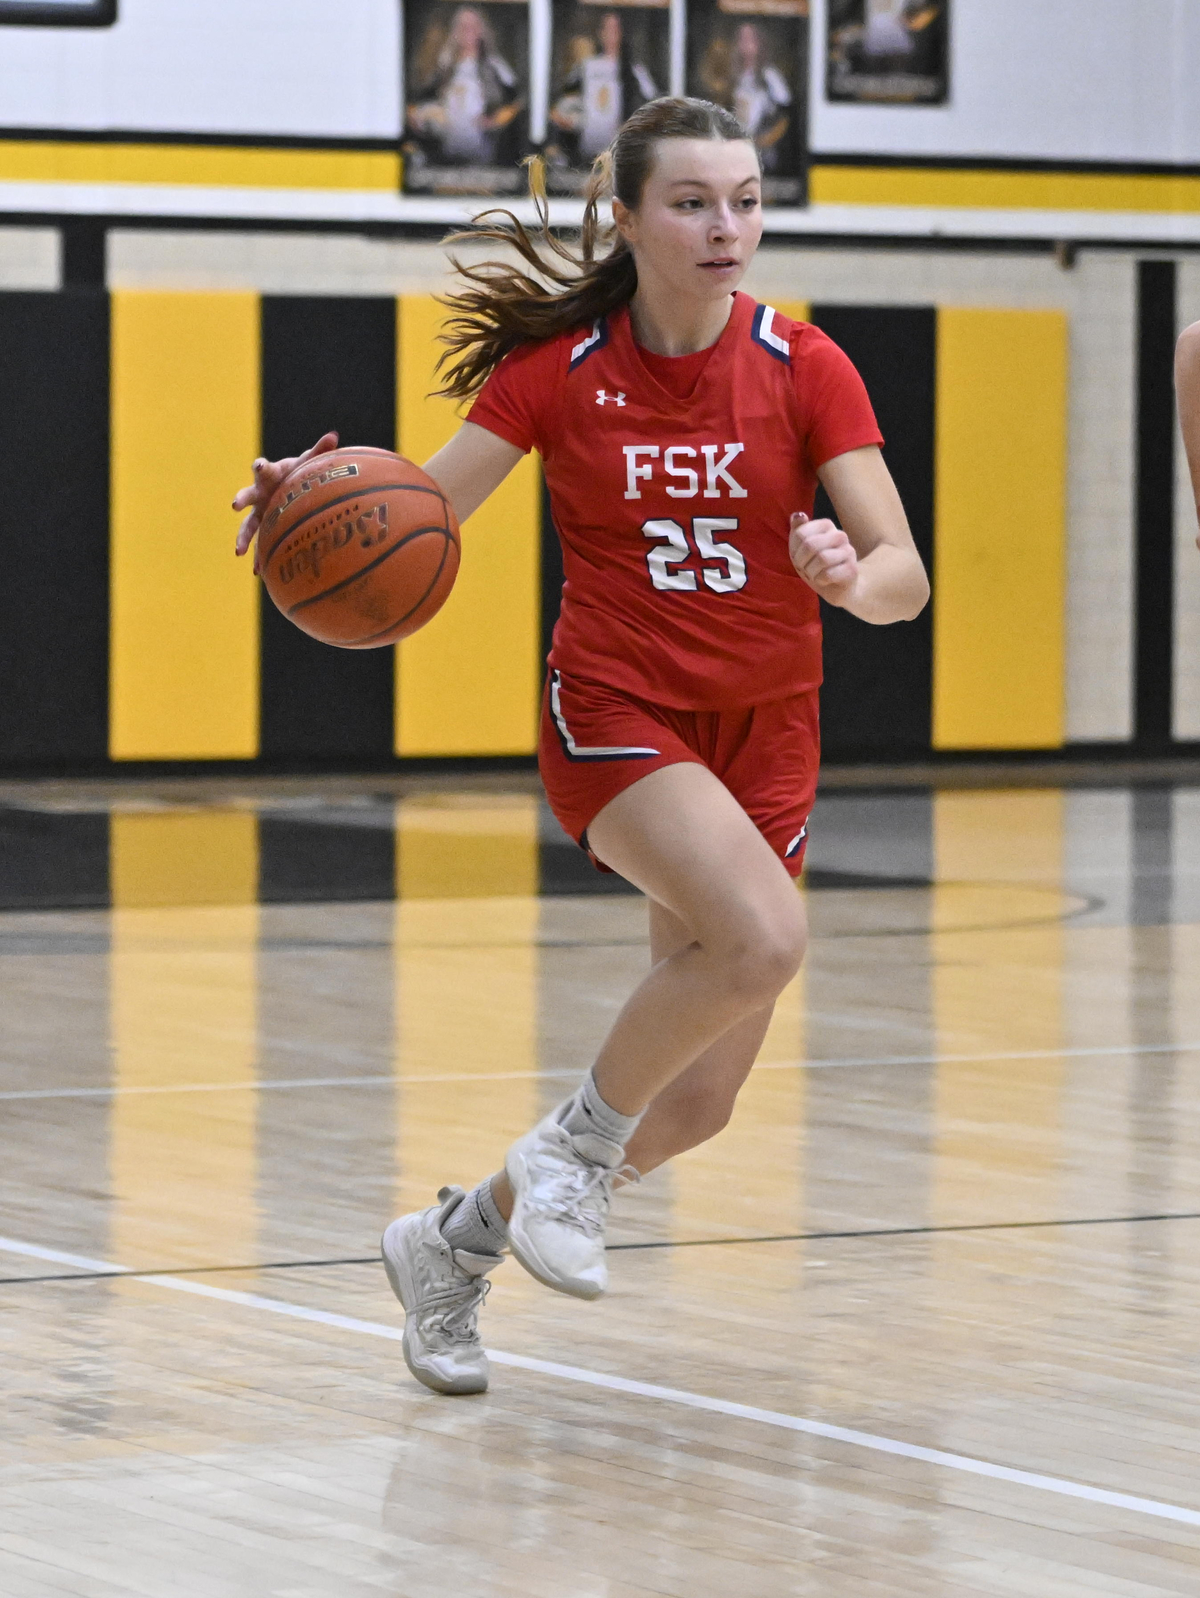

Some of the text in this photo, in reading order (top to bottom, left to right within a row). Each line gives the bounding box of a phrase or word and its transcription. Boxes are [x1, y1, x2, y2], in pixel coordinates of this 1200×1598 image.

[622, 442, 748, 500] FSK
[279, 501, 389, 585] Baden
[640, 517, 748, 594] 25
